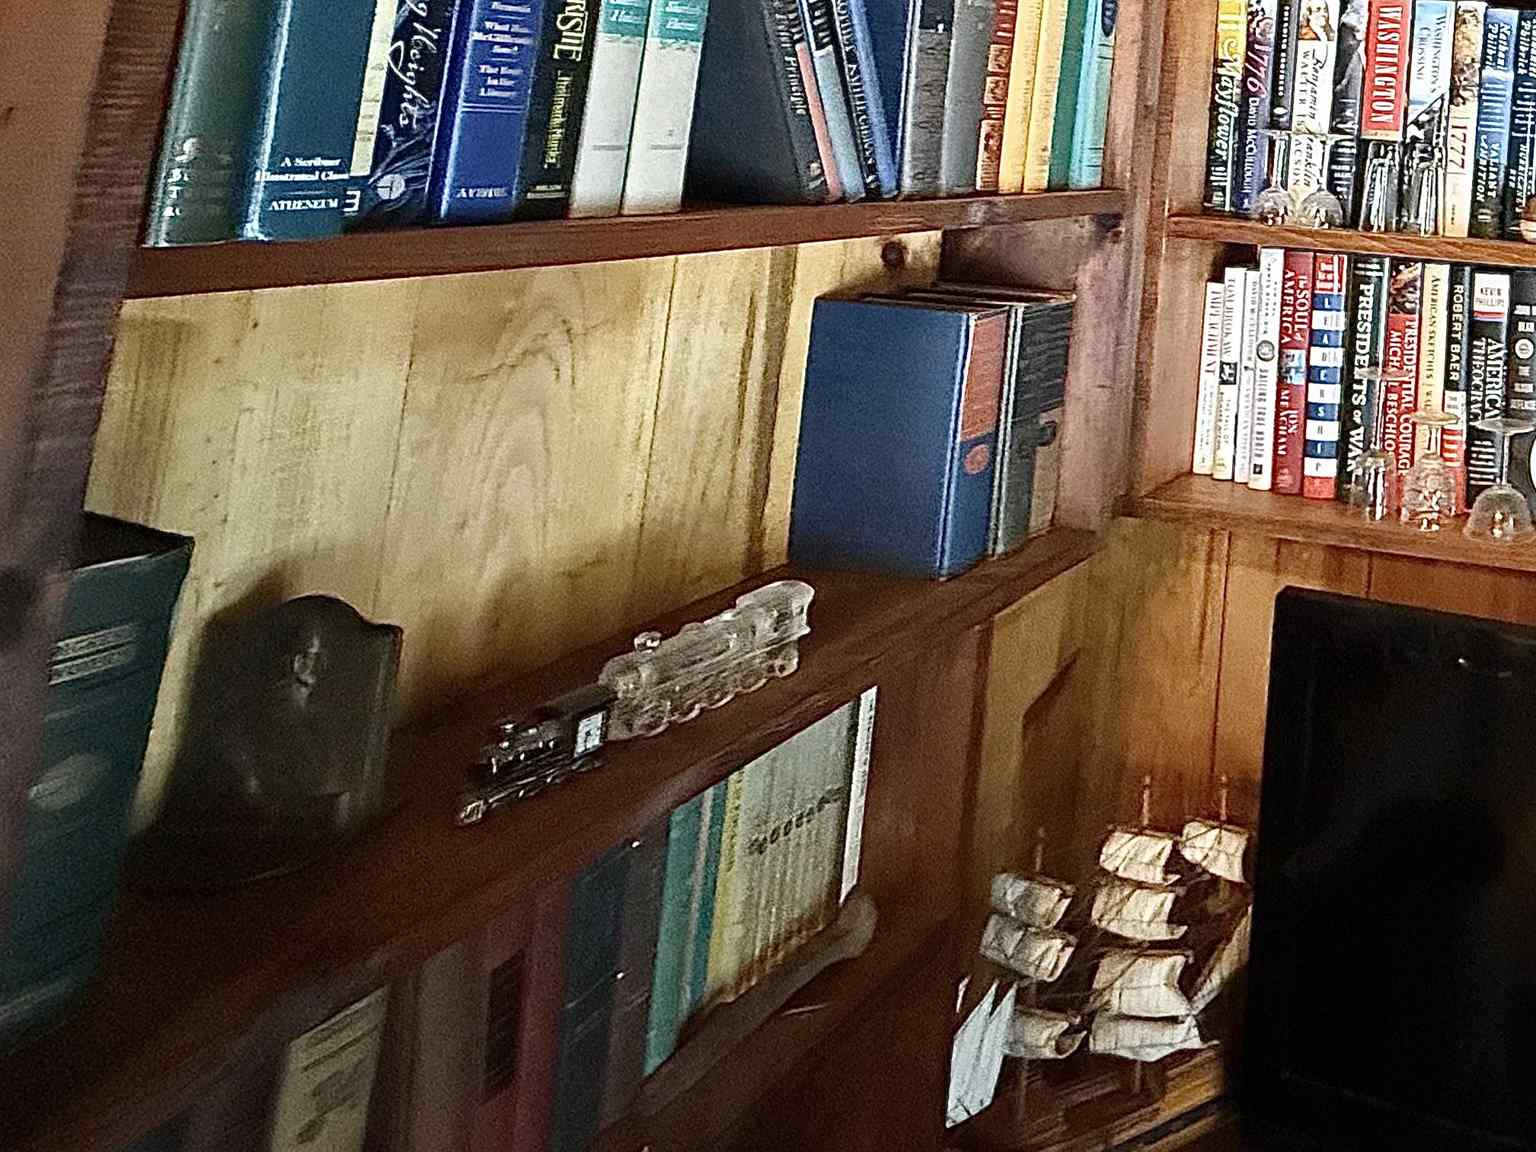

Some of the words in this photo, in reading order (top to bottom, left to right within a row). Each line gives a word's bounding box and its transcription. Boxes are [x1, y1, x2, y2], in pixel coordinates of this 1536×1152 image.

[385, 26, 439, 132] Heights
[781, 54, 807, 116] Principle
[1245, 43, 1270, 96] 1776
[1370, 6, 1404, 123] WASHINGTON
[1214, 54, 1243, 161] Mayflower
[1450, 124, 1468, 168] 1777
[1486, 141, 1502, 198] VALIANT
[268, 197, 339, 212] ATHENEUM
[1281, 269, 1297, 344] AMERICA
[1295, 288, 1309, 333] SOUL
[1429, 275, 1440, 328] AMERICAN
[1450, 284, 1465, 340] ROBERT
[1204, 290, 1222, 376] IMPEACHMENT
[1352, 284, 1375, 406] PRESIDENTS
[1449, 344, 1464, 382] BAER
[1469, 336, 1486, 429] THEOCRACY
[1277, 389, 1291, 455] MEACHAM
[1287, 410, 1299, 433] JON
